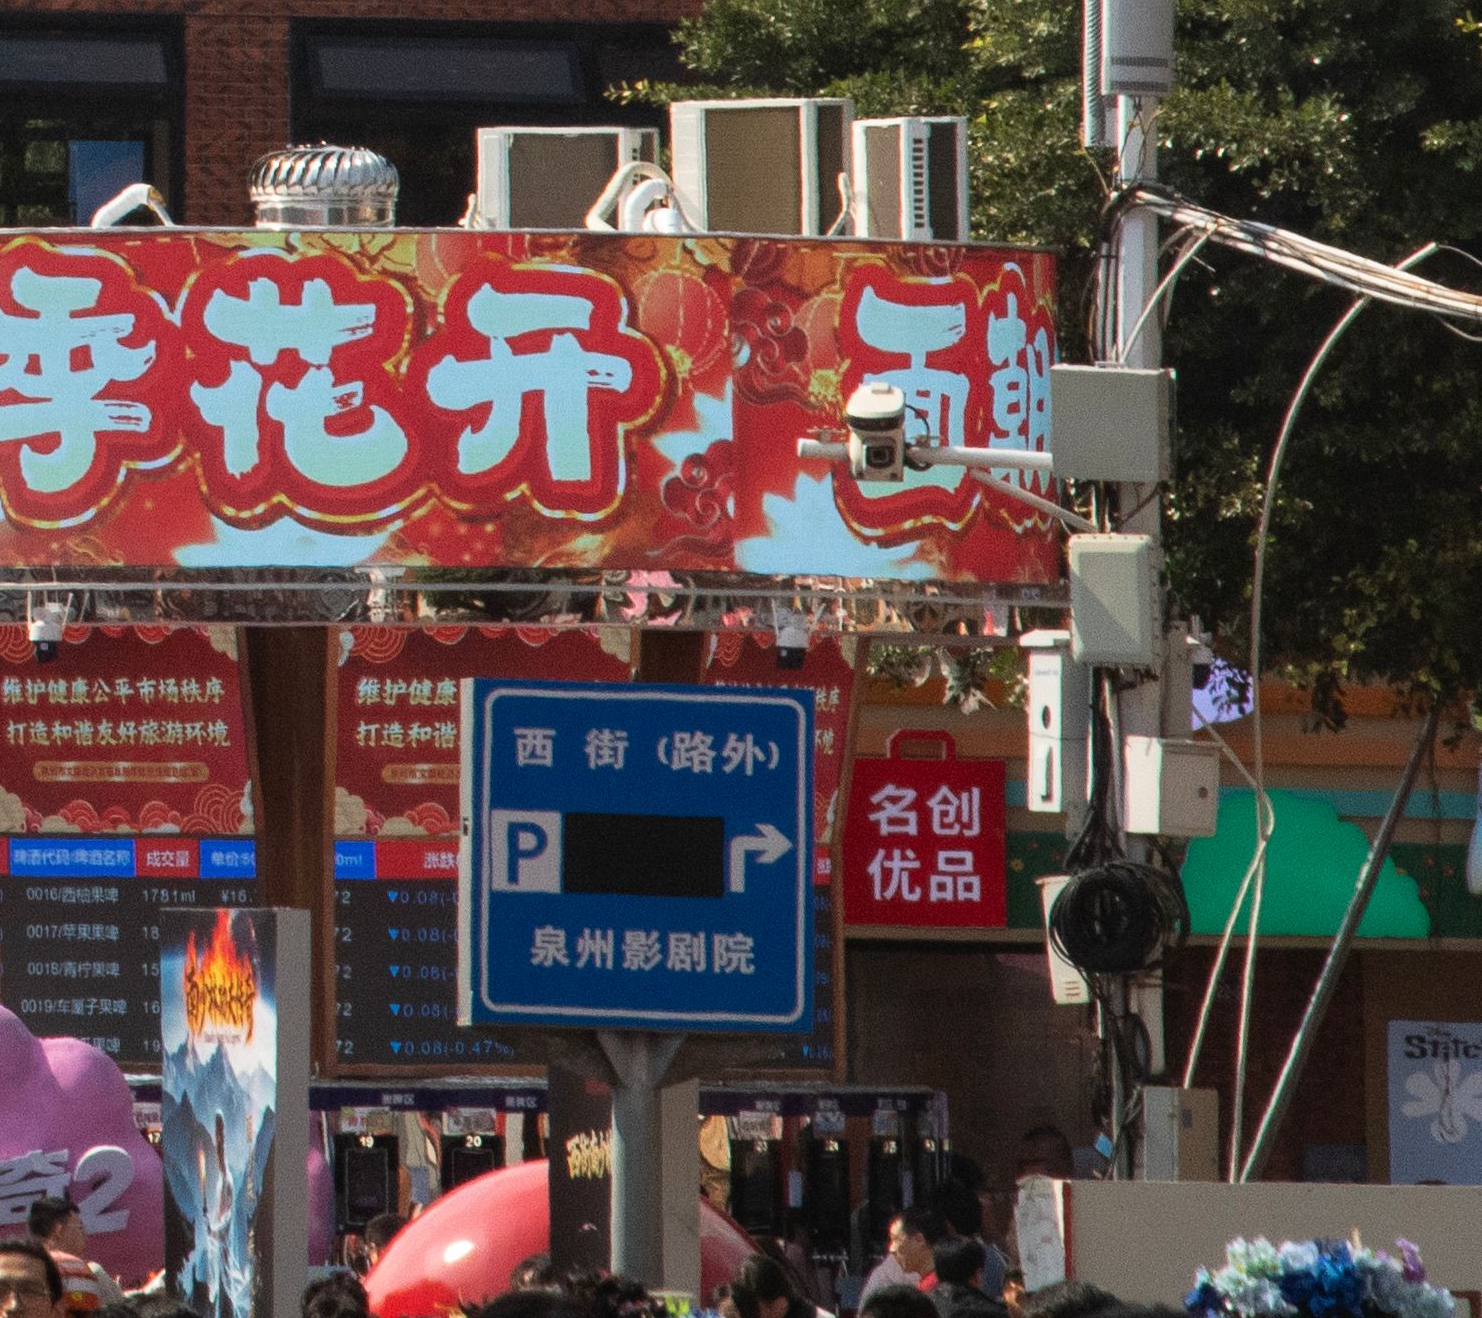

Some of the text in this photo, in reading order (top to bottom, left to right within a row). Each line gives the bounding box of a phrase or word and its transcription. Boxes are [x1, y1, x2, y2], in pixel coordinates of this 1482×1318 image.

[2, 677, 225, 705] 维护健康公平市场秩序
[6, 720, 231, 747] 打造和谐友好旅游环境
[868, 784, 981, 837] 名创
[146, 850, 190, 868] 成交量
[507, 821, 547, 886] P
[867, 848, 981, 902] 优品
[532, 925, 755, 975] 泉州影剧院
[464, 1135, 481, 1148] 20
